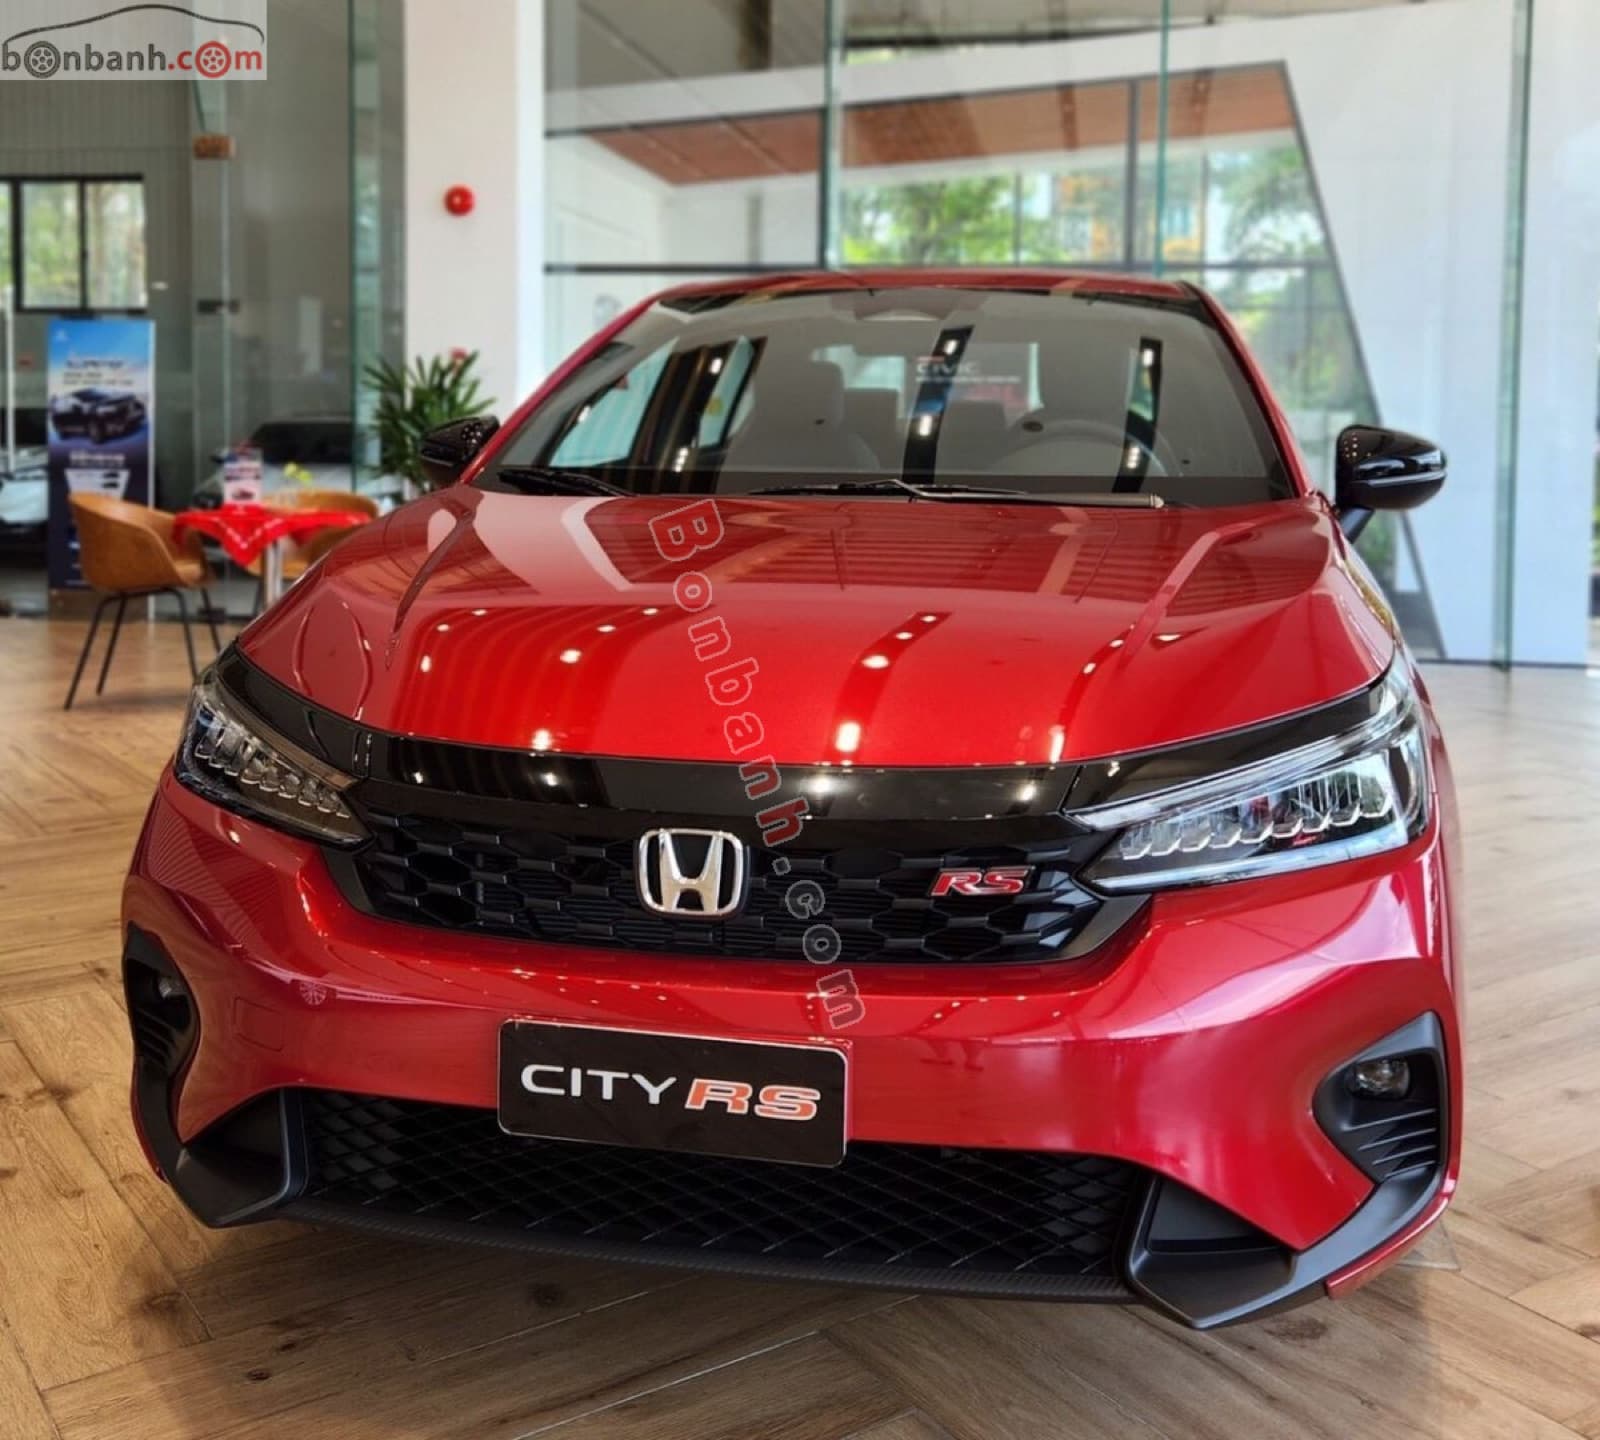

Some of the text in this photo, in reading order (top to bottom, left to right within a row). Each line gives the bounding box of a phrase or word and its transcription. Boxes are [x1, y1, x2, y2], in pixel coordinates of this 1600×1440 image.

[930, 866, 1035, 896] RS
[520, 1064, 821, 1121] CITY RS
